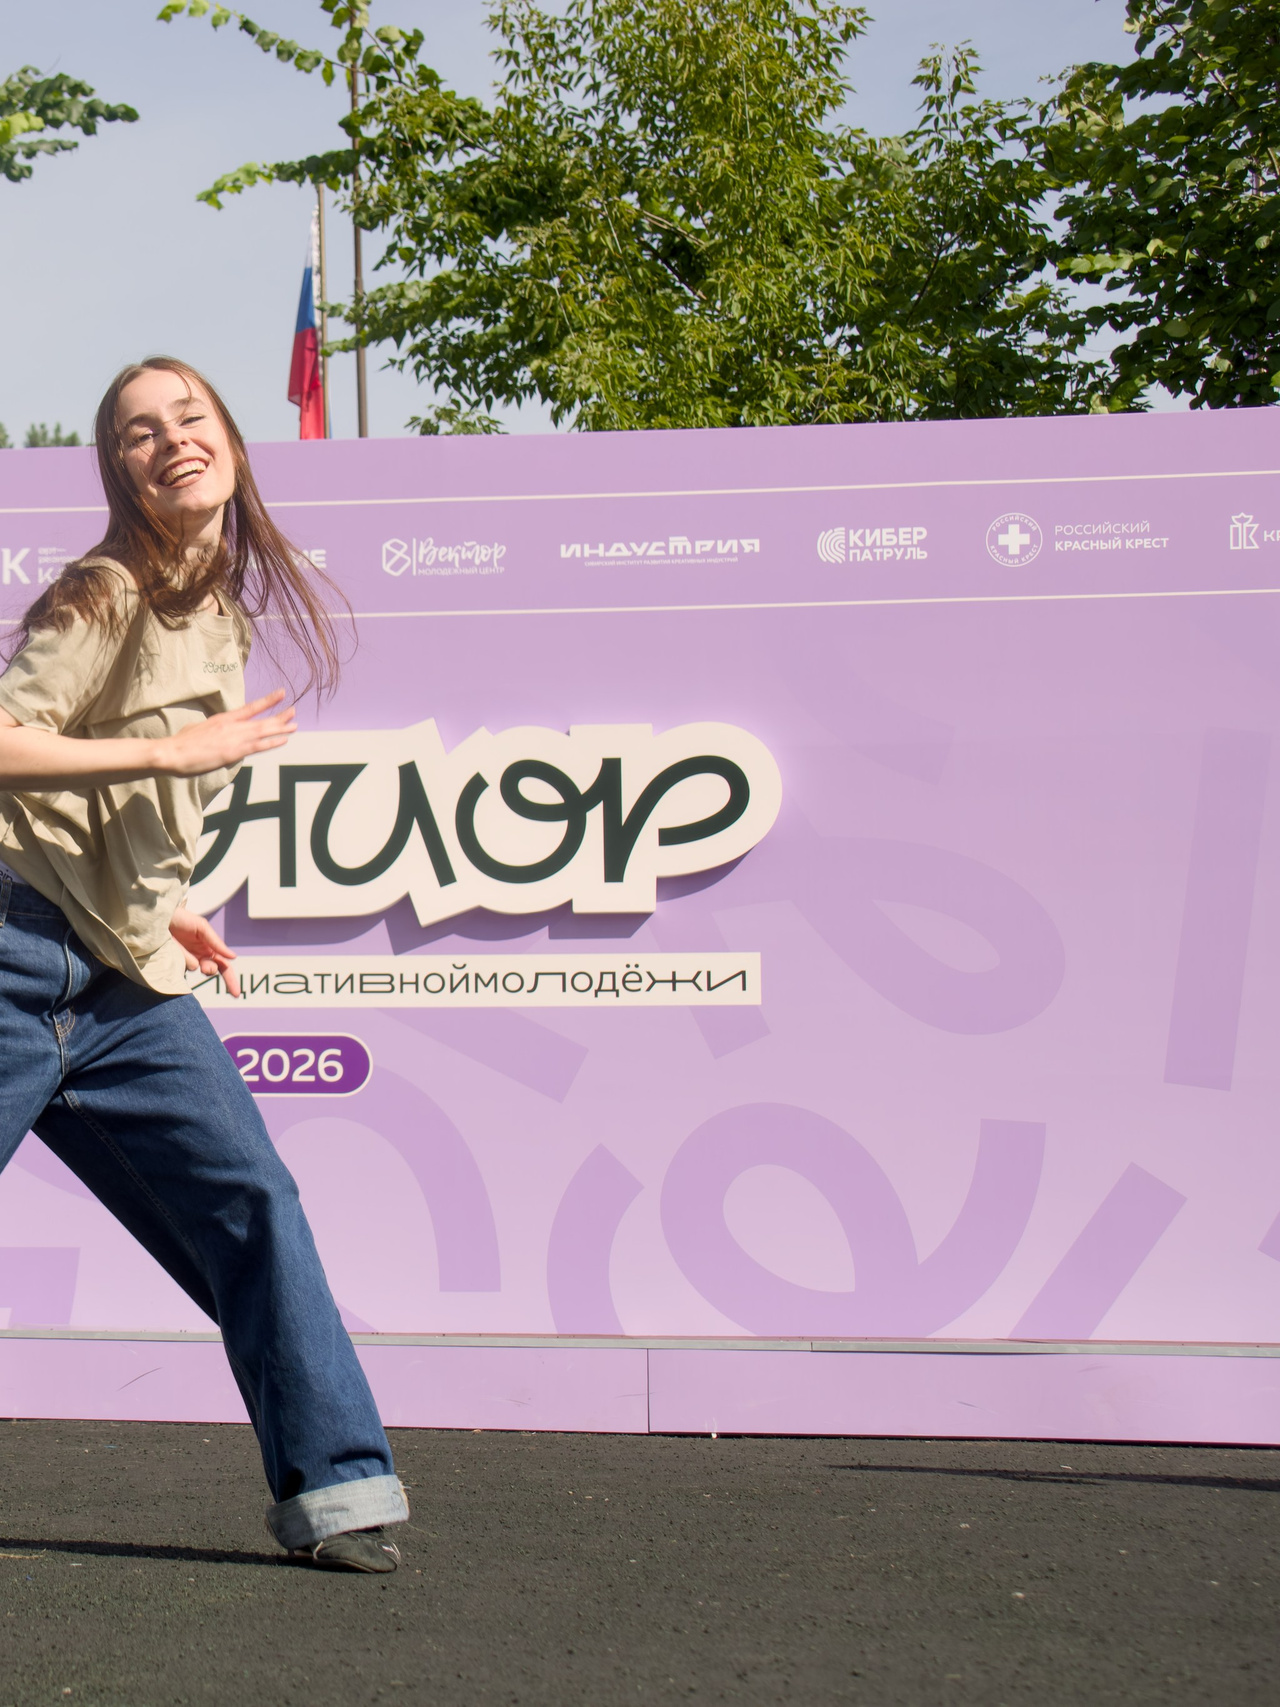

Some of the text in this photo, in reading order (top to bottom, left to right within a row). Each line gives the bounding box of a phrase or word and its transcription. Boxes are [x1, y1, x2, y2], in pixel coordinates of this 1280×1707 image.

[992, 515, 1038, 531] РОССИЙСКИЙ
[1055, 520, 1150, 535] РОССИЙСКИЙ
[560, 536, 760, 558] ИНДУСТРИЯ
[849, 526, 928, 547] КИБЕР
[1055, 537, 1169, 551] КРАСНЫЙ КРЕСТ
[418, 537, 508, 571] Вектор
[849, 546, 928, 562] ПАТРУЛЬ
[990, 543, 1038, 564] КРАСНЫЙ КРЕСТ
[237, 1047, 344, 1084] 2026
